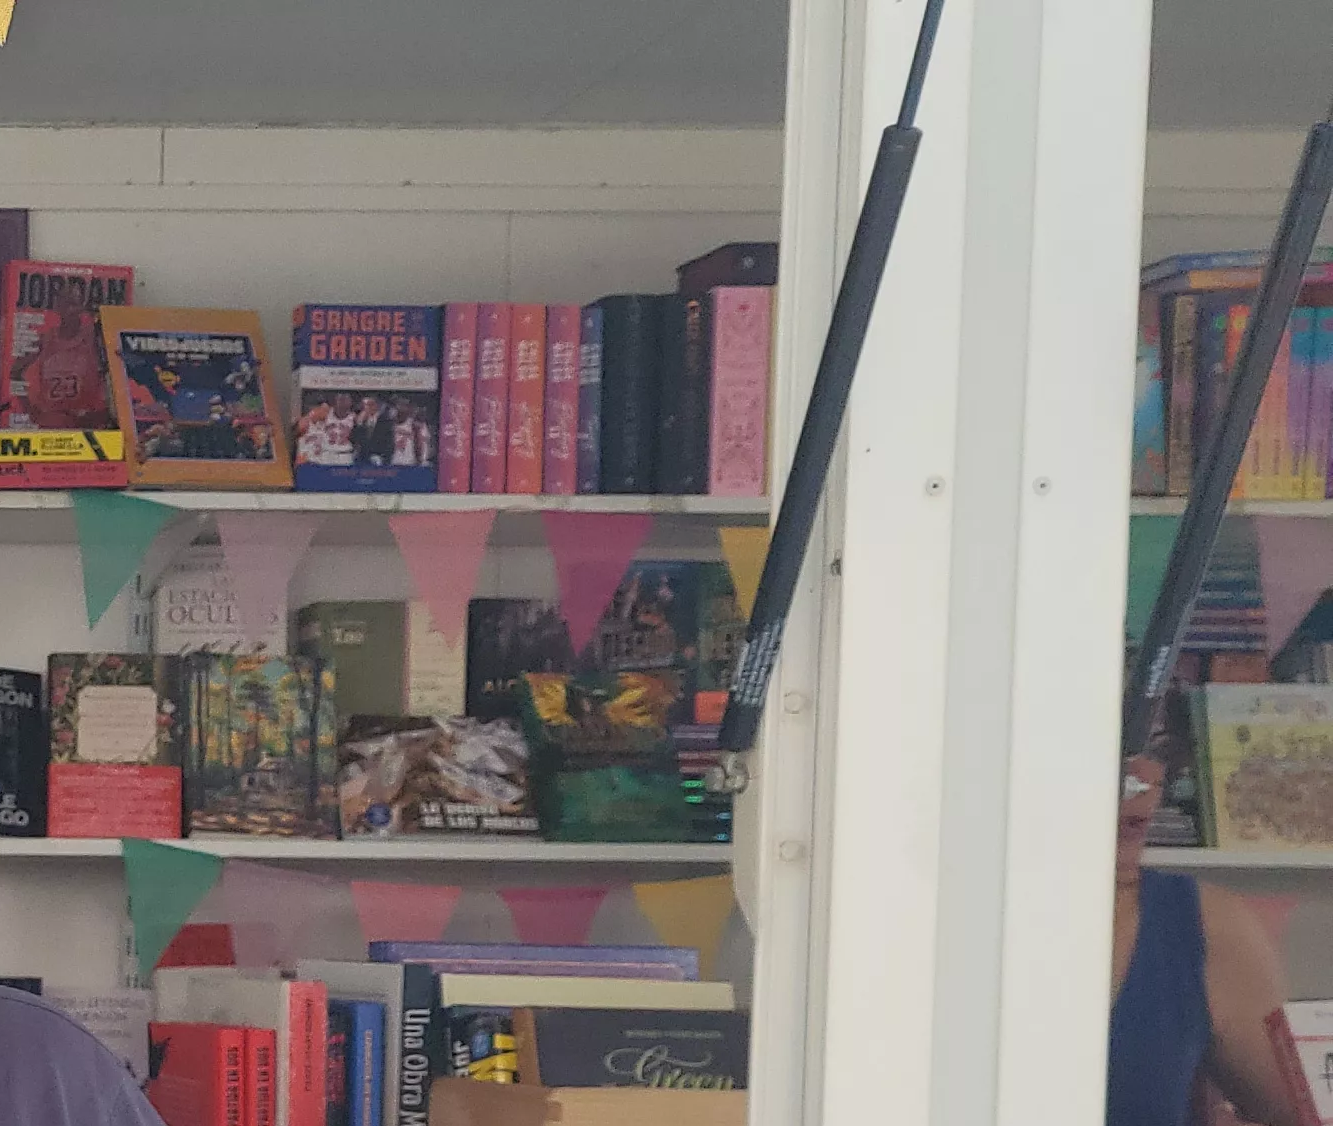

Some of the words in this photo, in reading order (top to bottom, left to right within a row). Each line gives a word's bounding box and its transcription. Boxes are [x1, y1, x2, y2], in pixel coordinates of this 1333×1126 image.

[17, 272, 126, 309] JORDAN
[310, 310, 406, 333] SANGRE
[310, 335, 428, 362] GARDEN
[403, 1008, 430, 1049] Una
[402, 1053, 428, 1107] Obra
